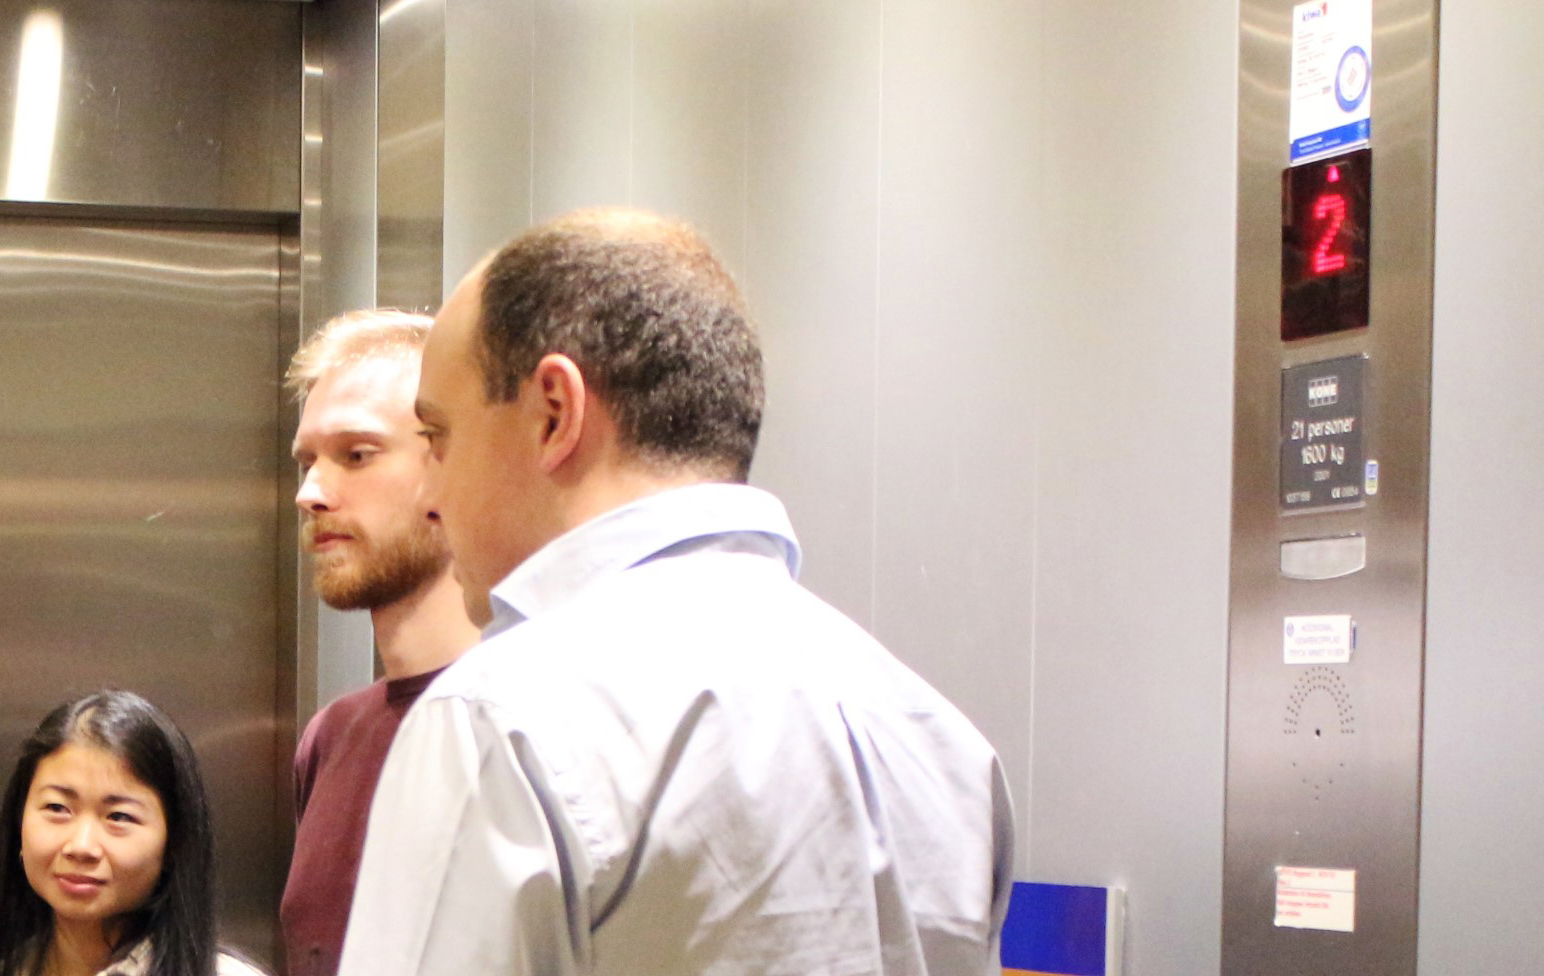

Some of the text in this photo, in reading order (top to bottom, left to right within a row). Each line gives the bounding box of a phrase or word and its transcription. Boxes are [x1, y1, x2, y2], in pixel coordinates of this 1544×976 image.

[1313, 194, 1346, 274] 2
[1308, 383, 1338, 400] KONE
[1291, 417, 1355, 441] 21 personer
[1301, 444, 1345, 465] 1600 kg
